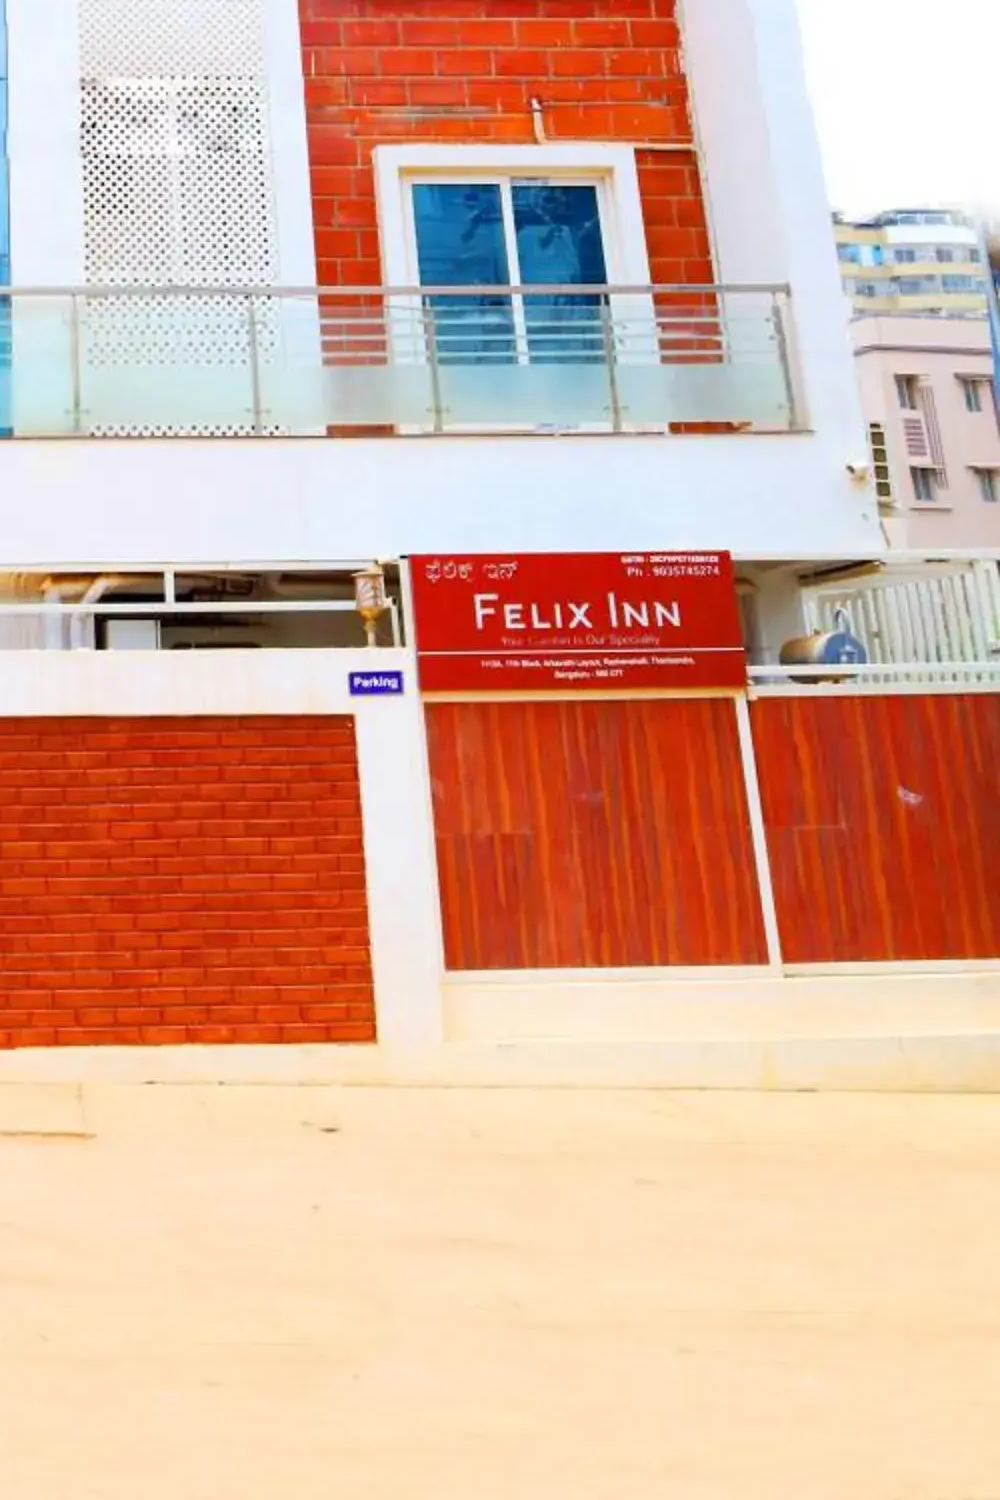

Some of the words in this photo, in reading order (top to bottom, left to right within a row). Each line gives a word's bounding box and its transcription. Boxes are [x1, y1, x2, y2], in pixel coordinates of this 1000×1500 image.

[626, 566, 643, 577] Ph
[473, 593, 593, 630] FELIX
[607, 592, 681, 628] INN
[585, 633, 605, 645] Our
[353, 675, 399, 689] Parking
